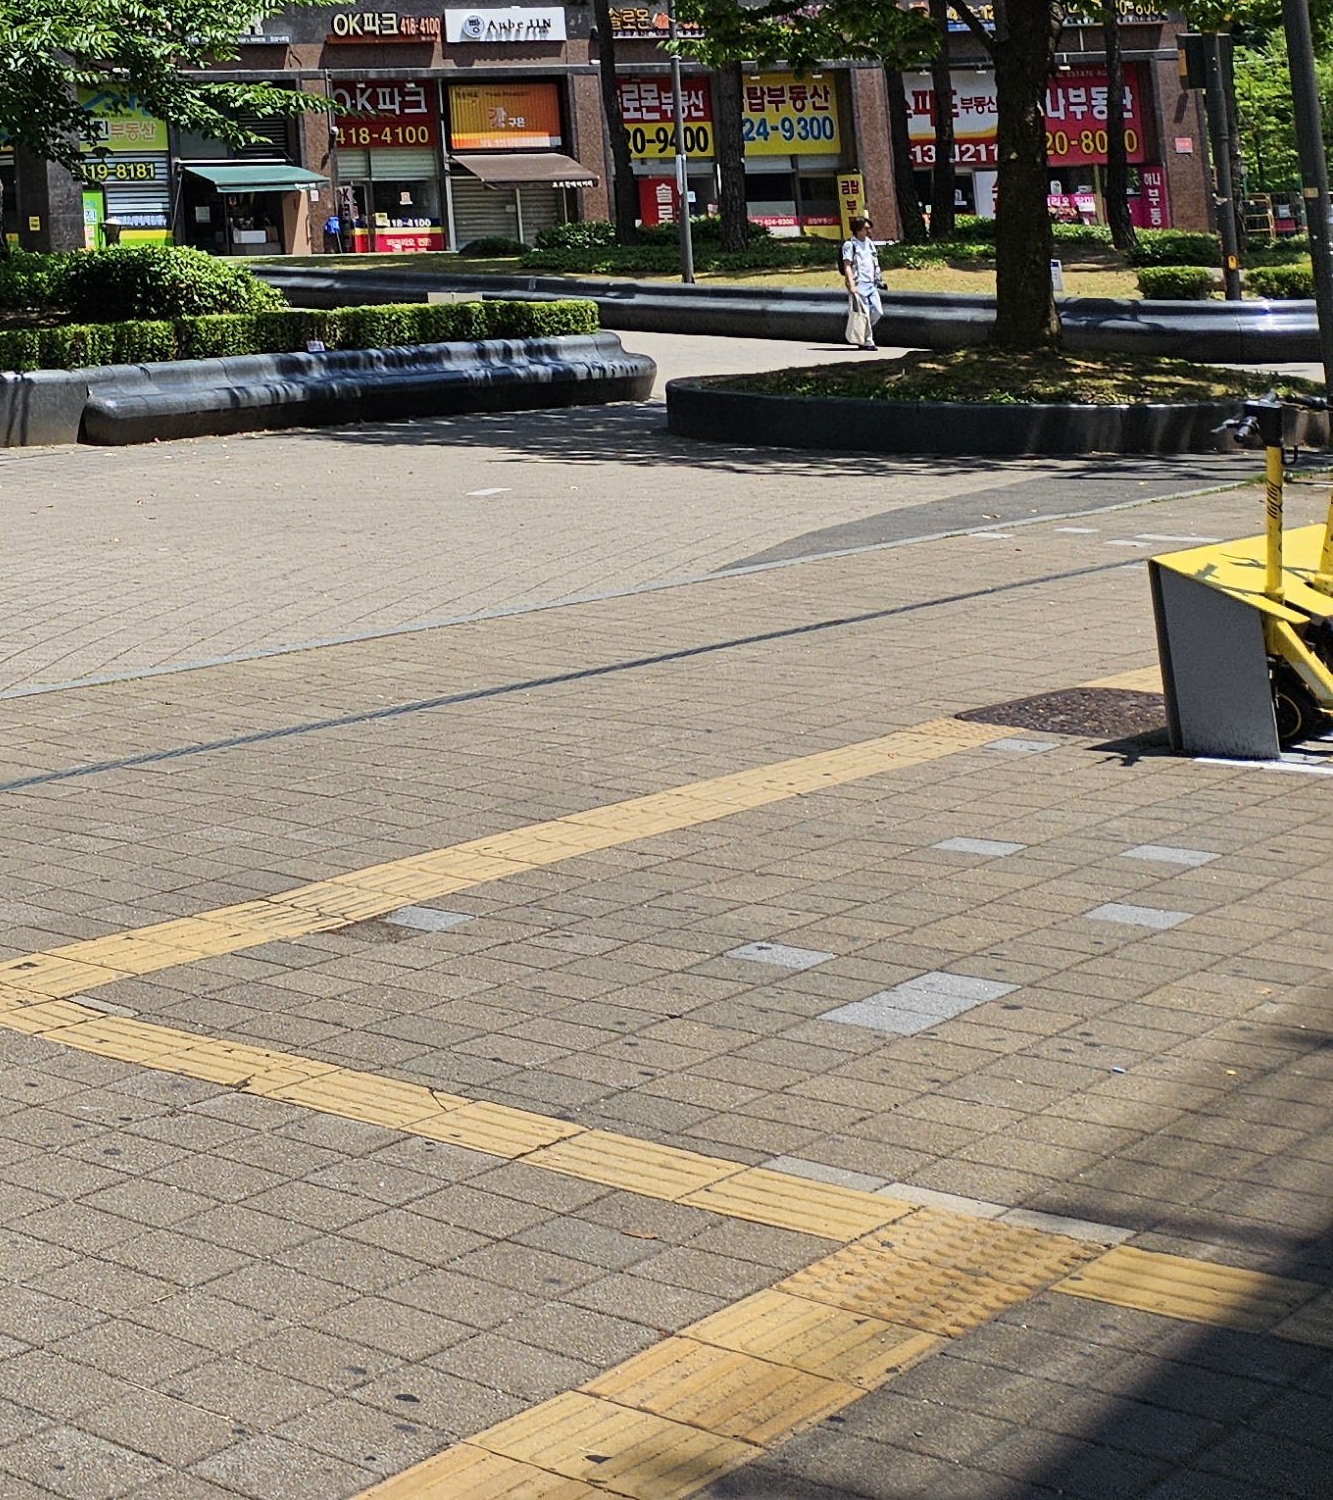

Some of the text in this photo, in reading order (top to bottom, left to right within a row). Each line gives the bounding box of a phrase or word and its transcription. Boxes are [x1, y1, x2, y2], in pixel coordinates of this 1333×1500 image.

[334, 12, 399, 36] OK파크
[608, 8, 649, 30] 솔로몬
[620, 83, 705, 120] 로몬부동산
[743, 84, 830, 113] 탑부동산
[1046, 85, 1133, 121] 나부동
[335, 125, 429, 145] 418-4100
[624, 125, 709, 154] 0-9400
[743, 115, 834, 142] 24-9300
[1046, 128, 1138, 155] 20-800
[910, 143, 998, 164] 131211
